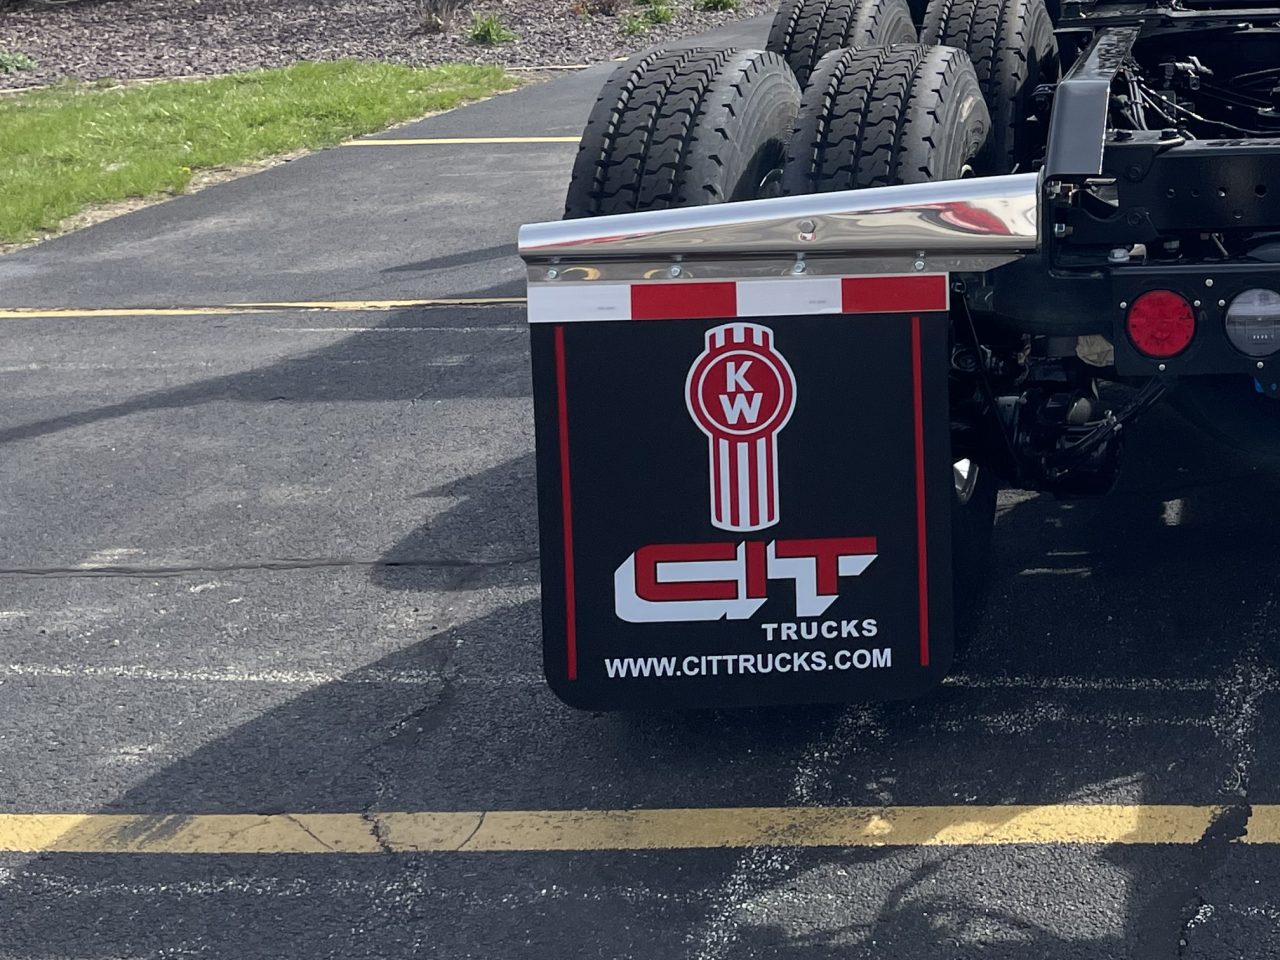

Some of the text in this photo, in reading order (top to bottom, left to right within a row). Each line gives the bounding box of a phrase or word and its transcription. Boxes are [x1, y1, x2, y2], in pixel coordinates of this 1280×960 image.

[726, 360, 754, 393] K
[718, 392, 763, 425] W
[614, 536, 878, 623] CIT
[761, 619, 878, 641] TRUCKS
[604, 648, 892, 679] WWW.CITTRUCKS.COM
